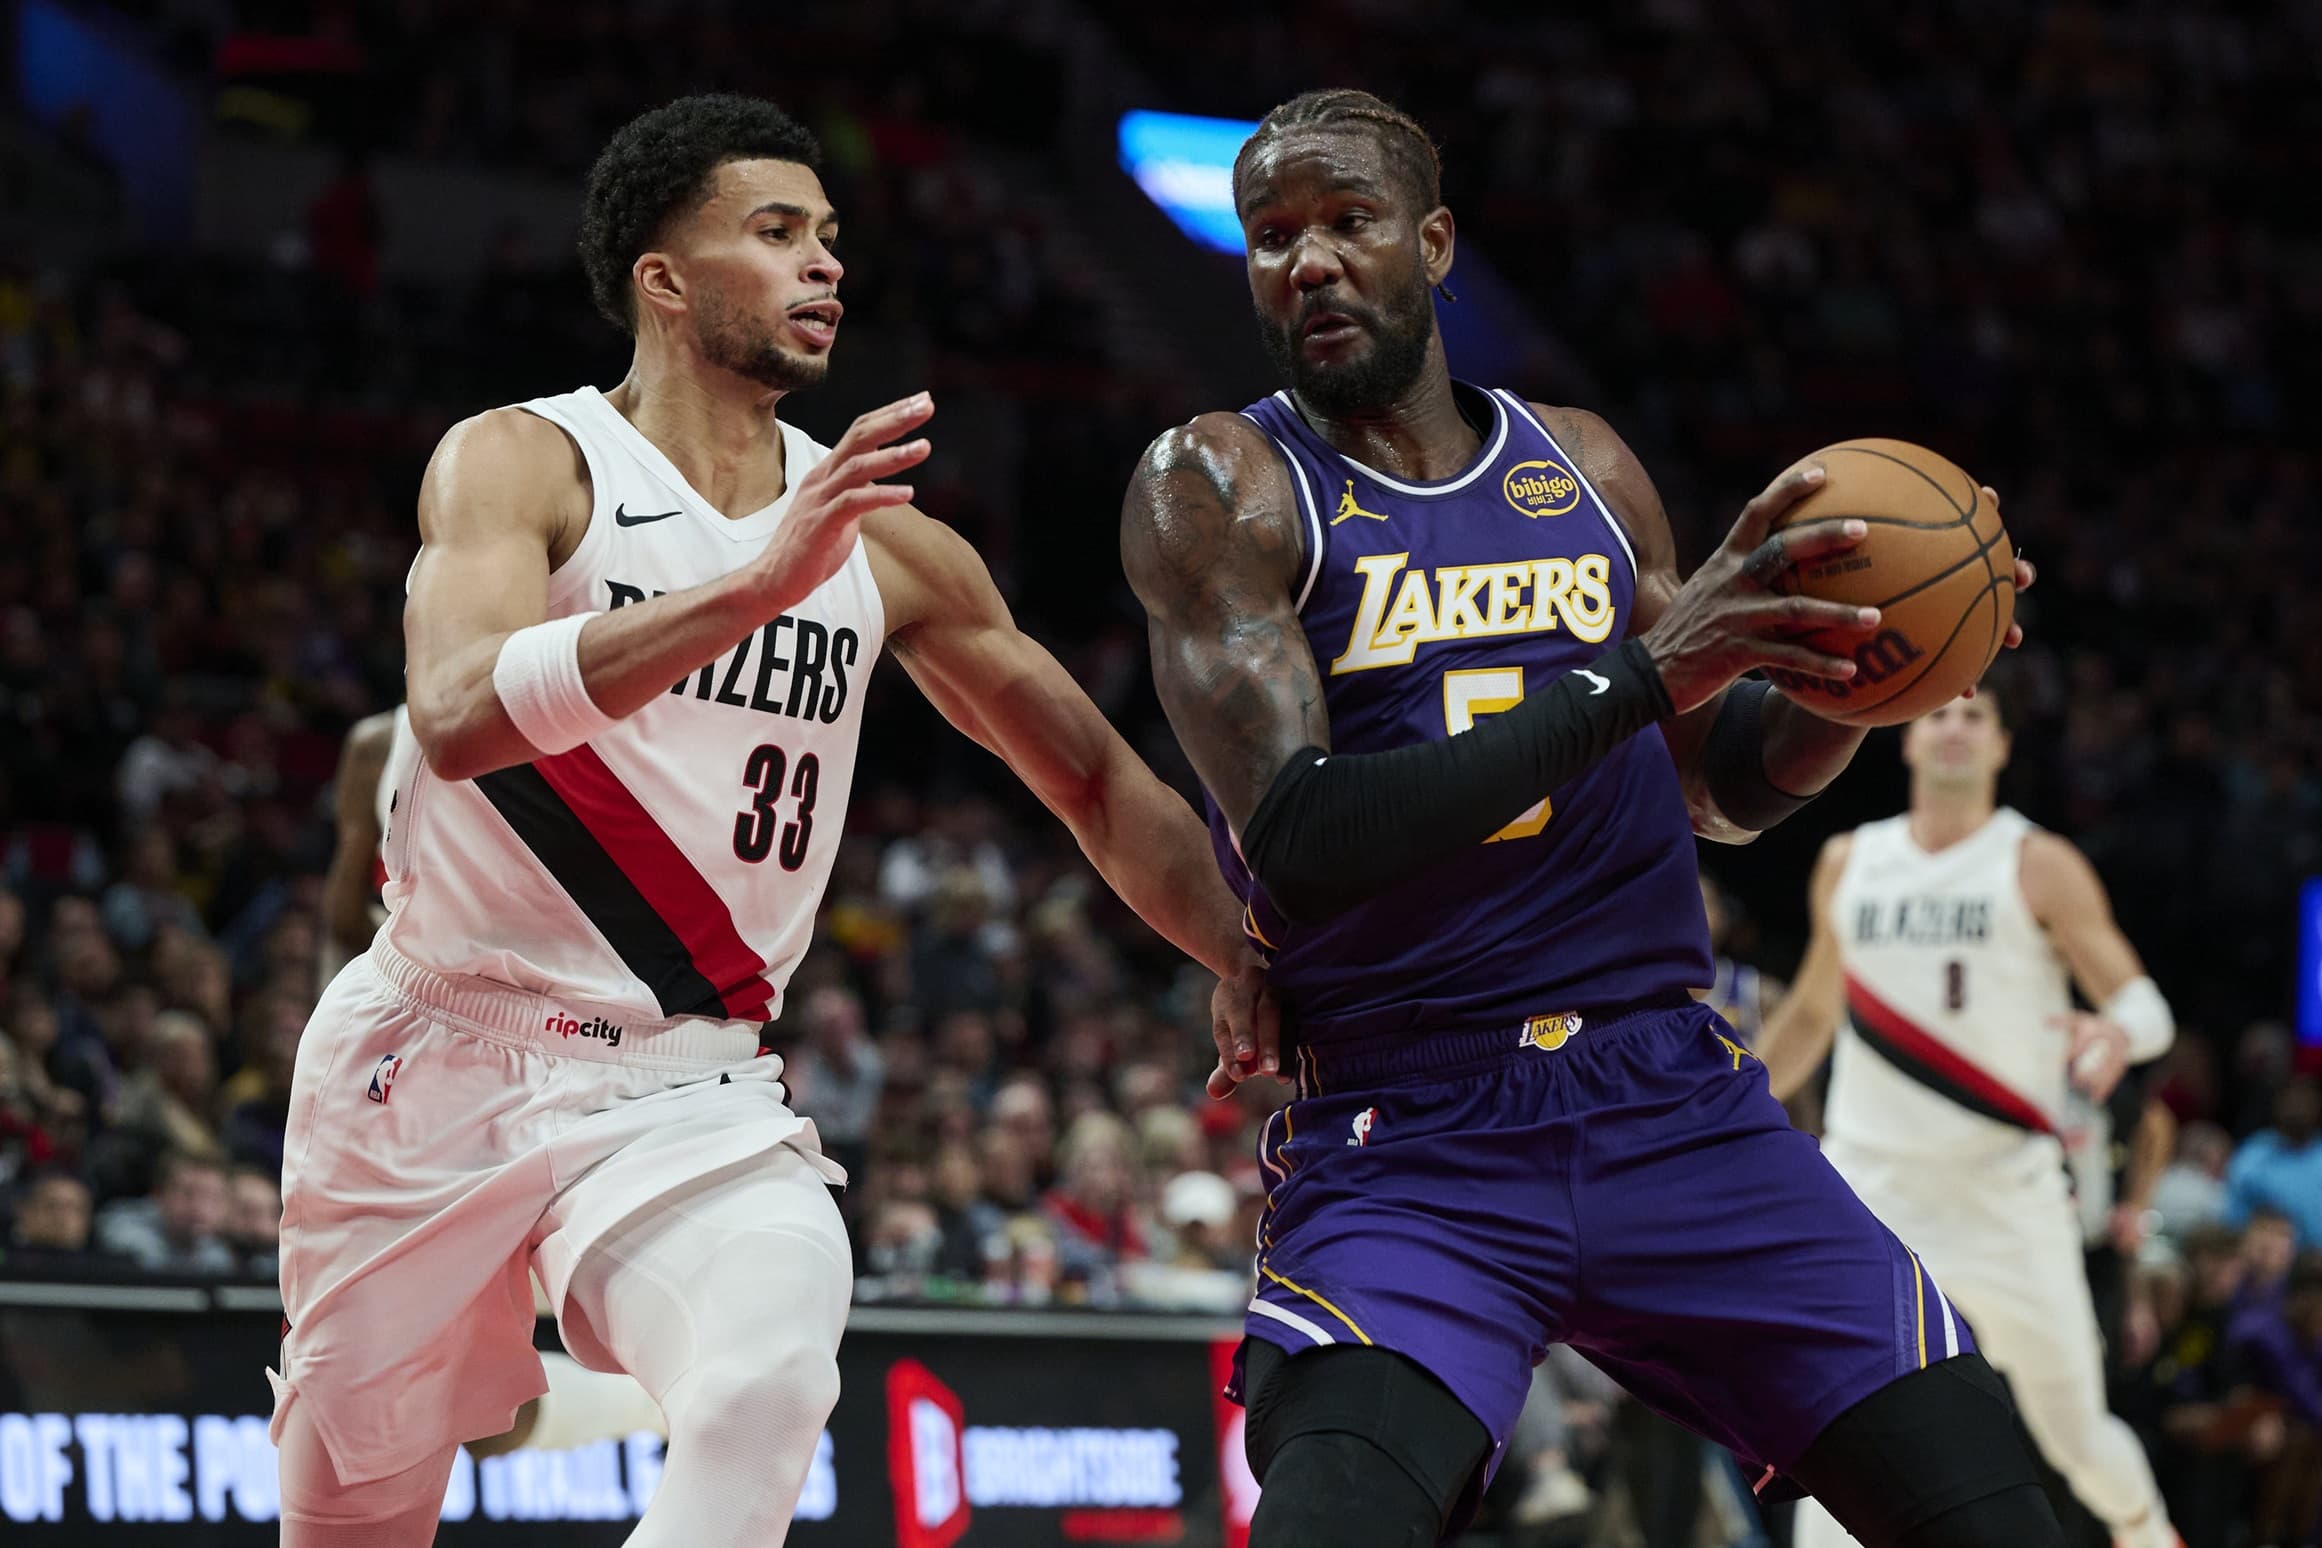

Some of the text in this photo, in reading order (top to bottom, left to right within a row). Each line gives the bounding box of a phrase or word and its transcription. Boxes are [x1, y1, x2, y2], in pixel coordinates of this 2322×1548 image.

[1509, 475, 1574, 498] bibigo
[1330, 552, 1616, 676] LAKERS
[733, 744, 819, 872] 33
[0, 1412, 74, 1522] OF
[75, 1413, 193, 1522] THE
